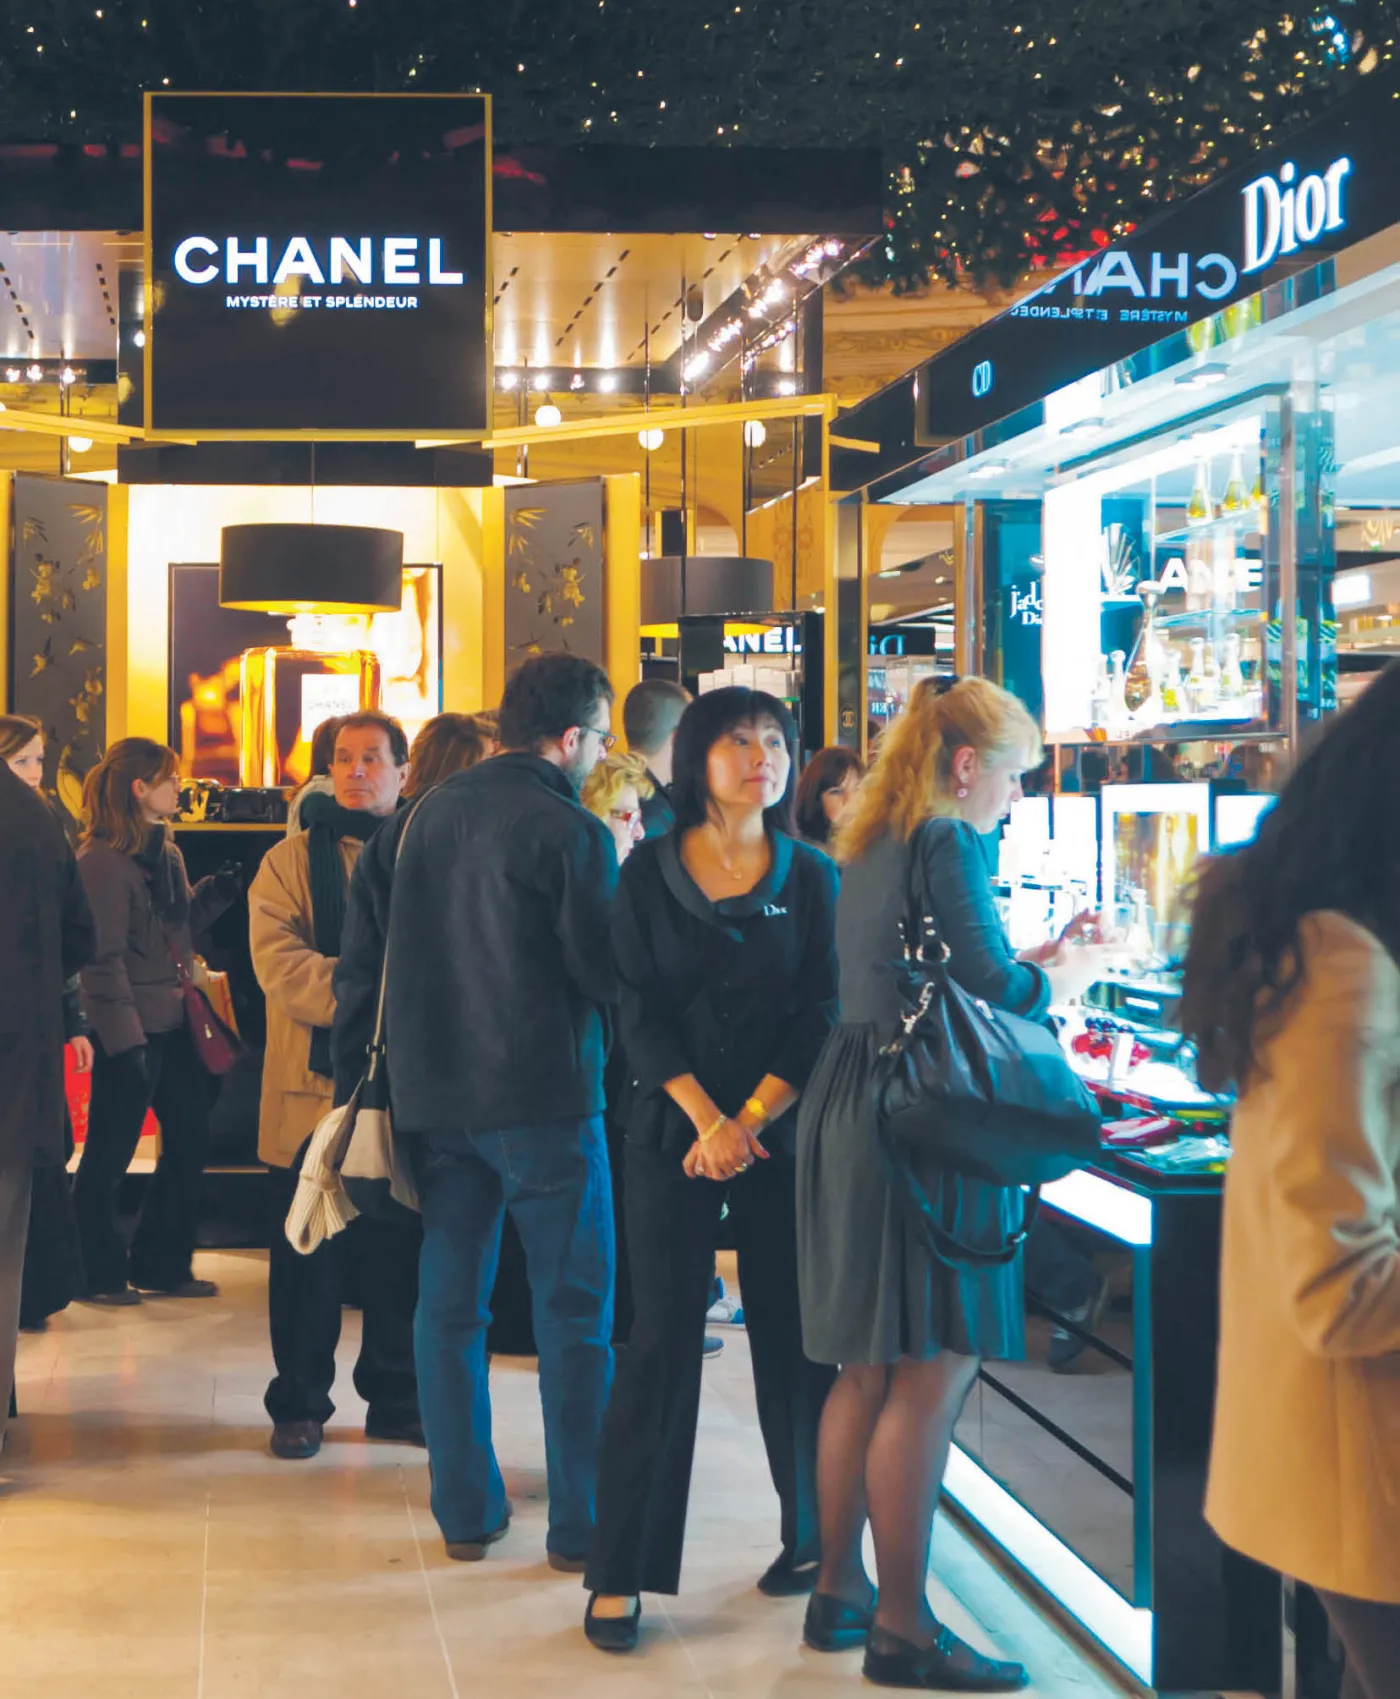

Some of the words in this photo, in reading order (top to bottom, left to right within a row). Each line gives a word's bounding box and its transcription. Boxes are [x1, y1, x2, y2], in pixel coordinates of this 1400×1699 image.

[1241, 157, 1350, 274] Dior
[174, 236, 464, 284] CHANEL
[226, 295, 299, 308] MYSTÈRE
[302, 296, 323, 308] ET
[325, 296, 418, 309] SPLENDEUR
